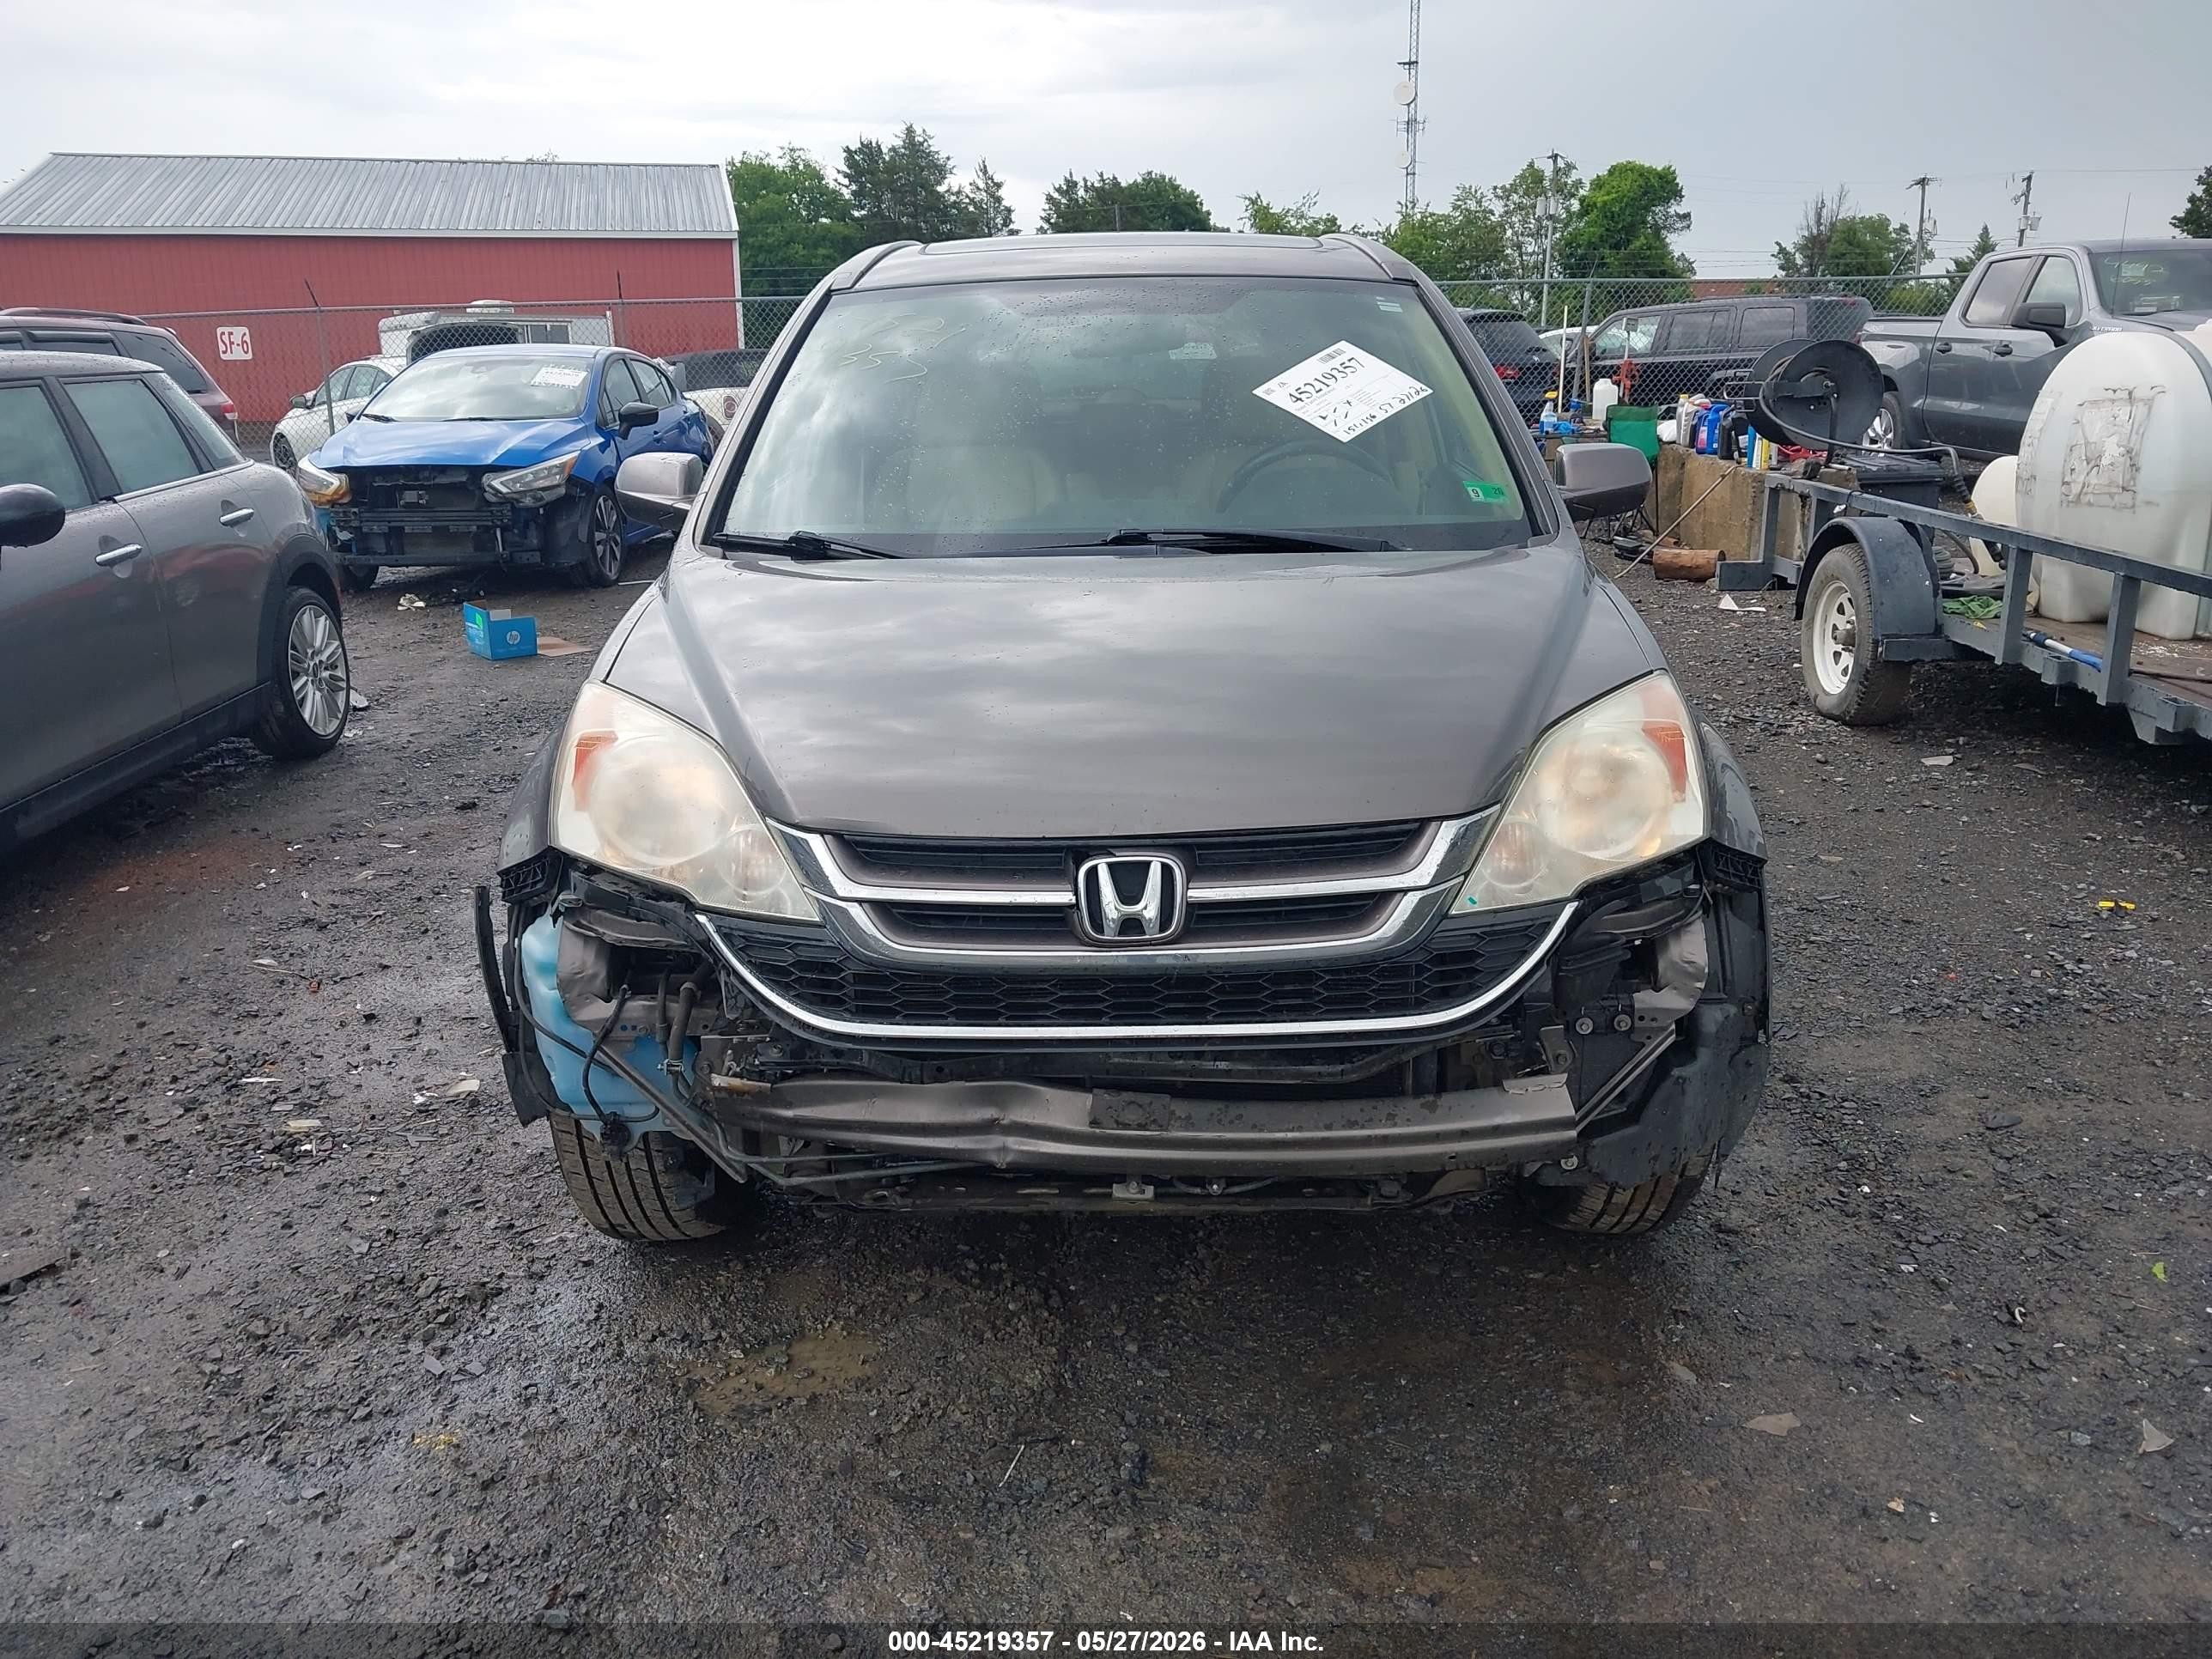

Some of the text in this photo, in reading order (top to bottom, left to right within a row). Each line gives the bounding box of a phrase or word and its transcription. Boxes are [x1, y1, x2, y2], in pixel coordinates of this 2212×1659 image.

[219, 331, 249, 355] SF-6
[1289, 356, 1365, 404] 45219357
[507, 630, 520, 645] hp
